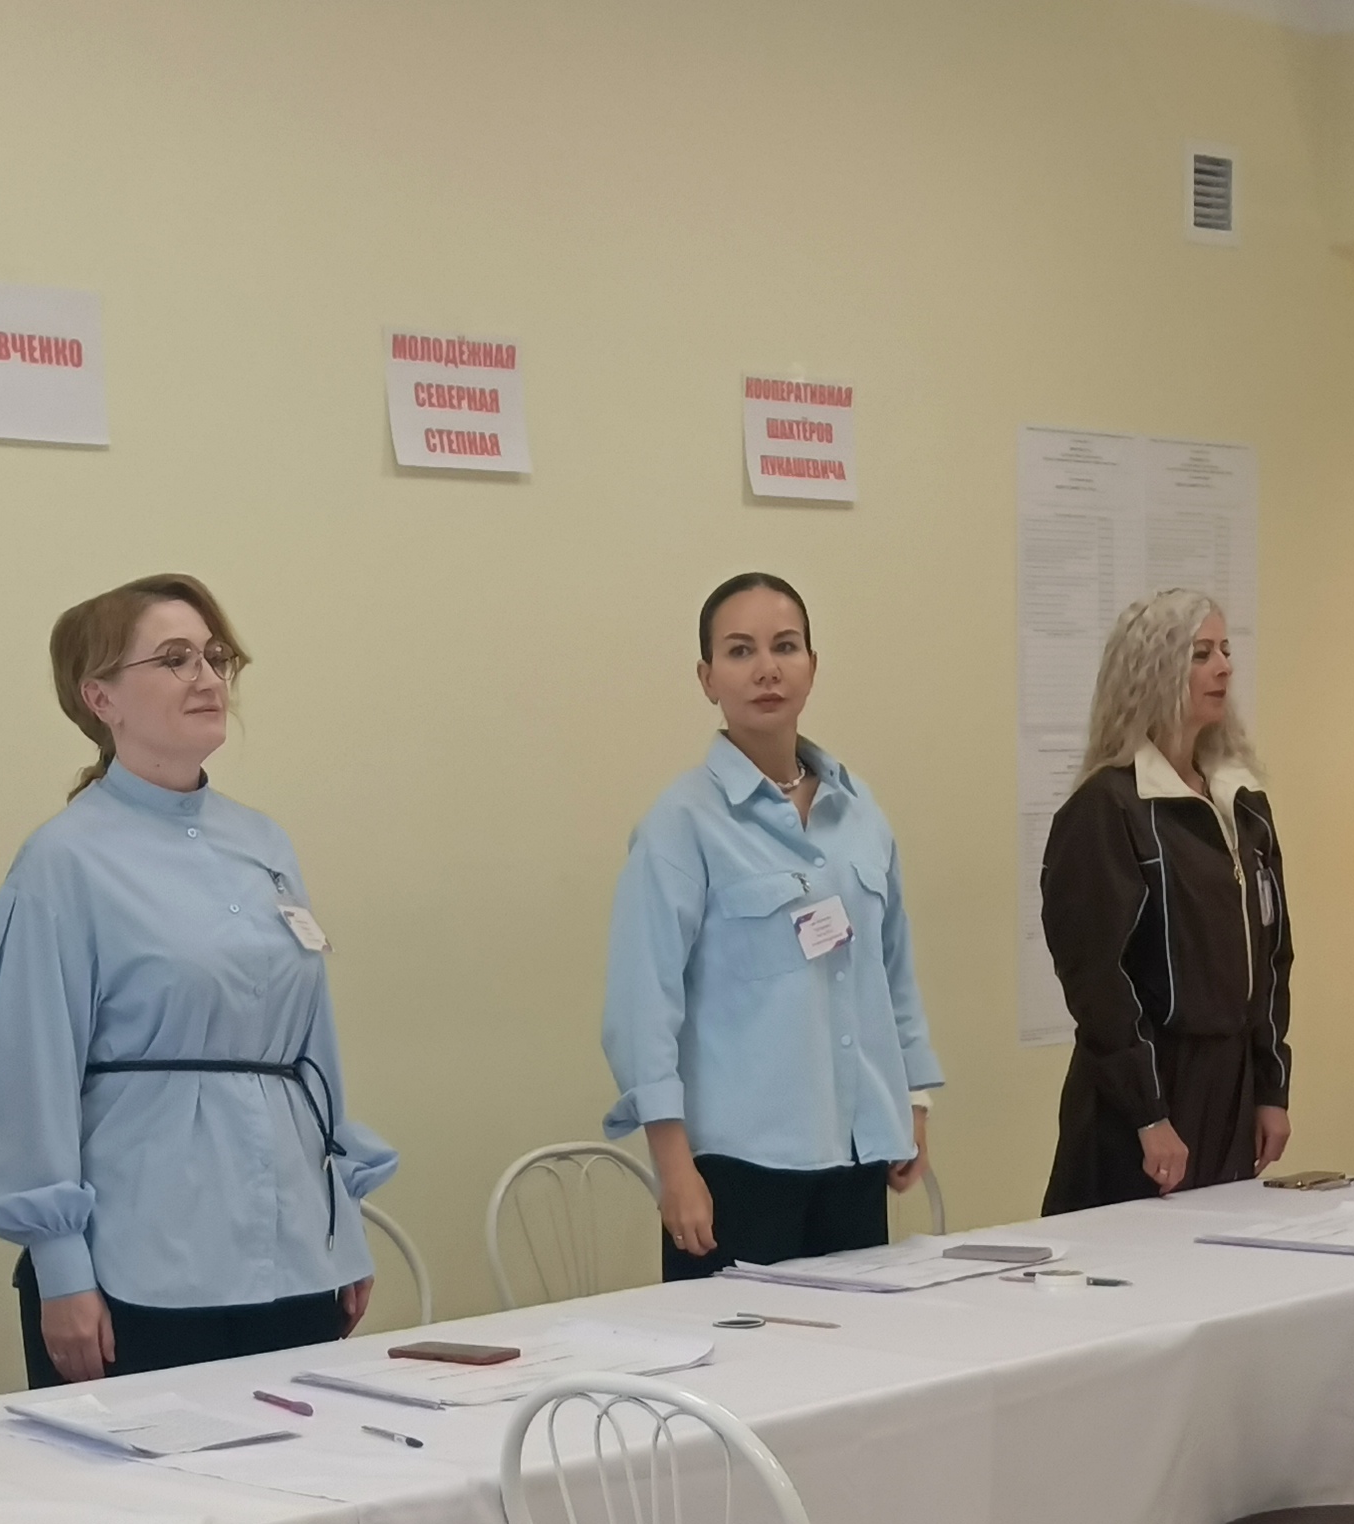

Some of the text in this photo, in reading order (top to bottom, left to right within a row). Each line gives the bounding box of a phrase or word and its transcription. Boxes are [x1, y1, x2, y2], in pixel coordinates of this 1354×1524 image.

[391, 333, 517, 370] МОЛОДЁЖНАЯ
[413, 381, 501, 414] СЕВЕРНАЯ
[744, 376, 854, 408] КООПЕРАТИВНАЯ
[424, 427, 502, 457] СТЕПНАЯ
[765, 416, 834, 444] ШАХТЁРОВ
[759, 454, 847, 481] ЛУКАШЕВИЧА
